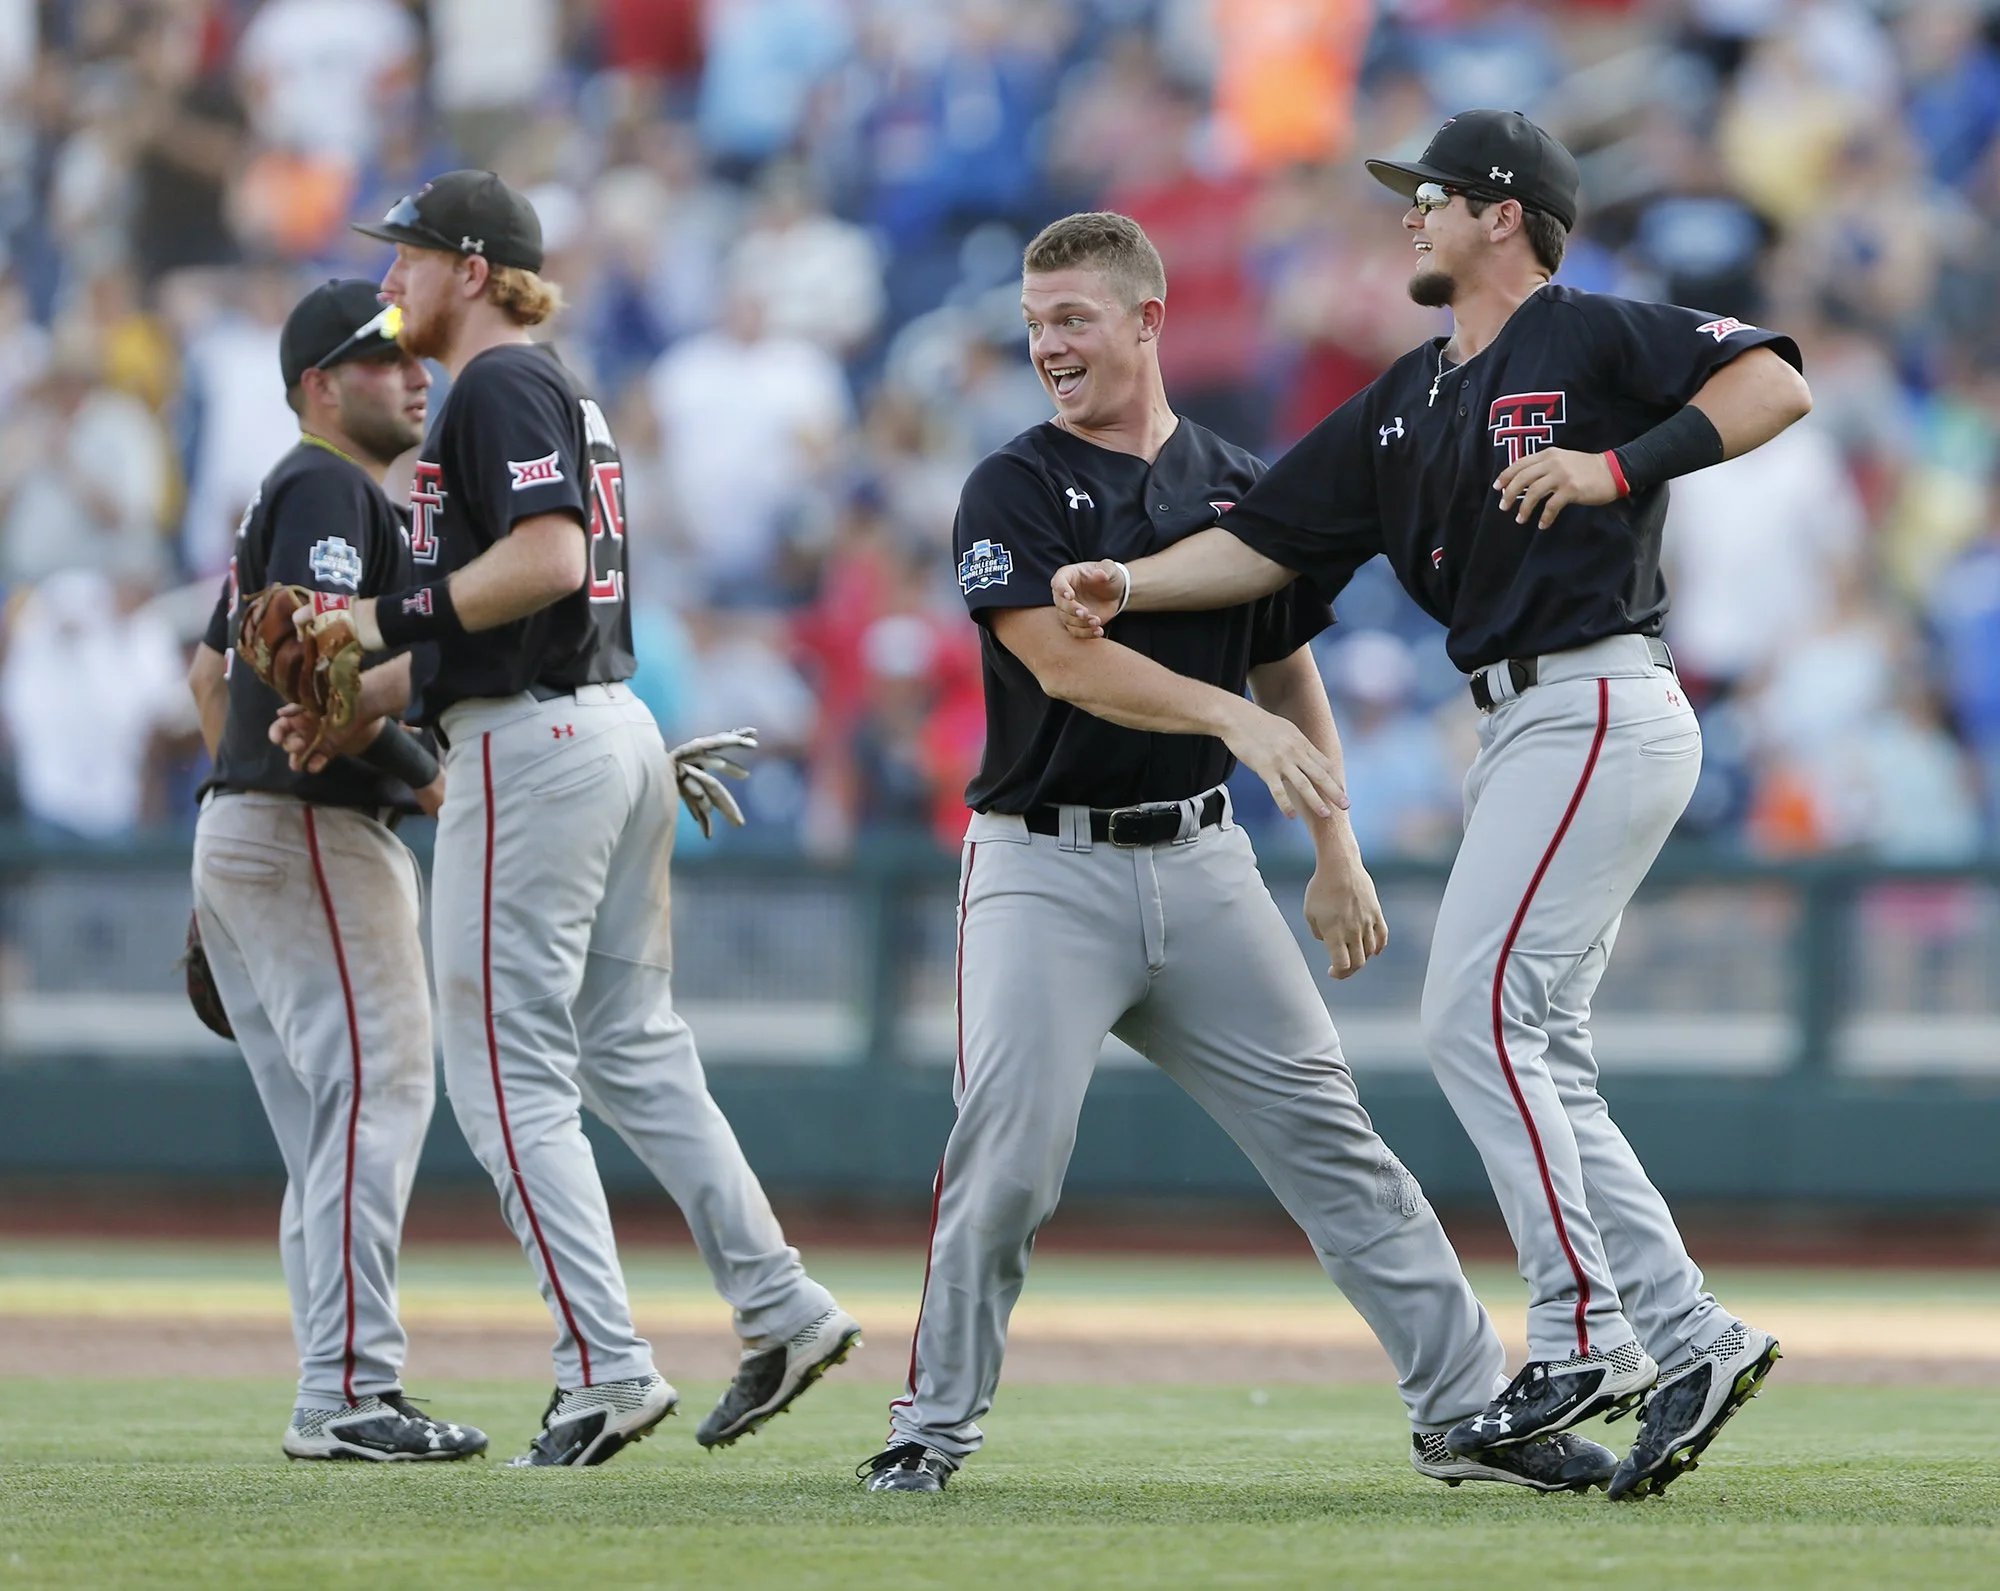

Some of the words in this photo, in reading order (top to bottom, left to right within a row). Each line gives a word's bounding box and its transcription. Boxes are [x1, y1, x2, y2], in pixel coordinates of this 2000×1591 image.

[511, 456, 559, 486] XII
[961, 568, 983, 582] WORLD
[984, 563, 1009, 574] SERIES
[969, 559, 998, 572] COLLEGE
